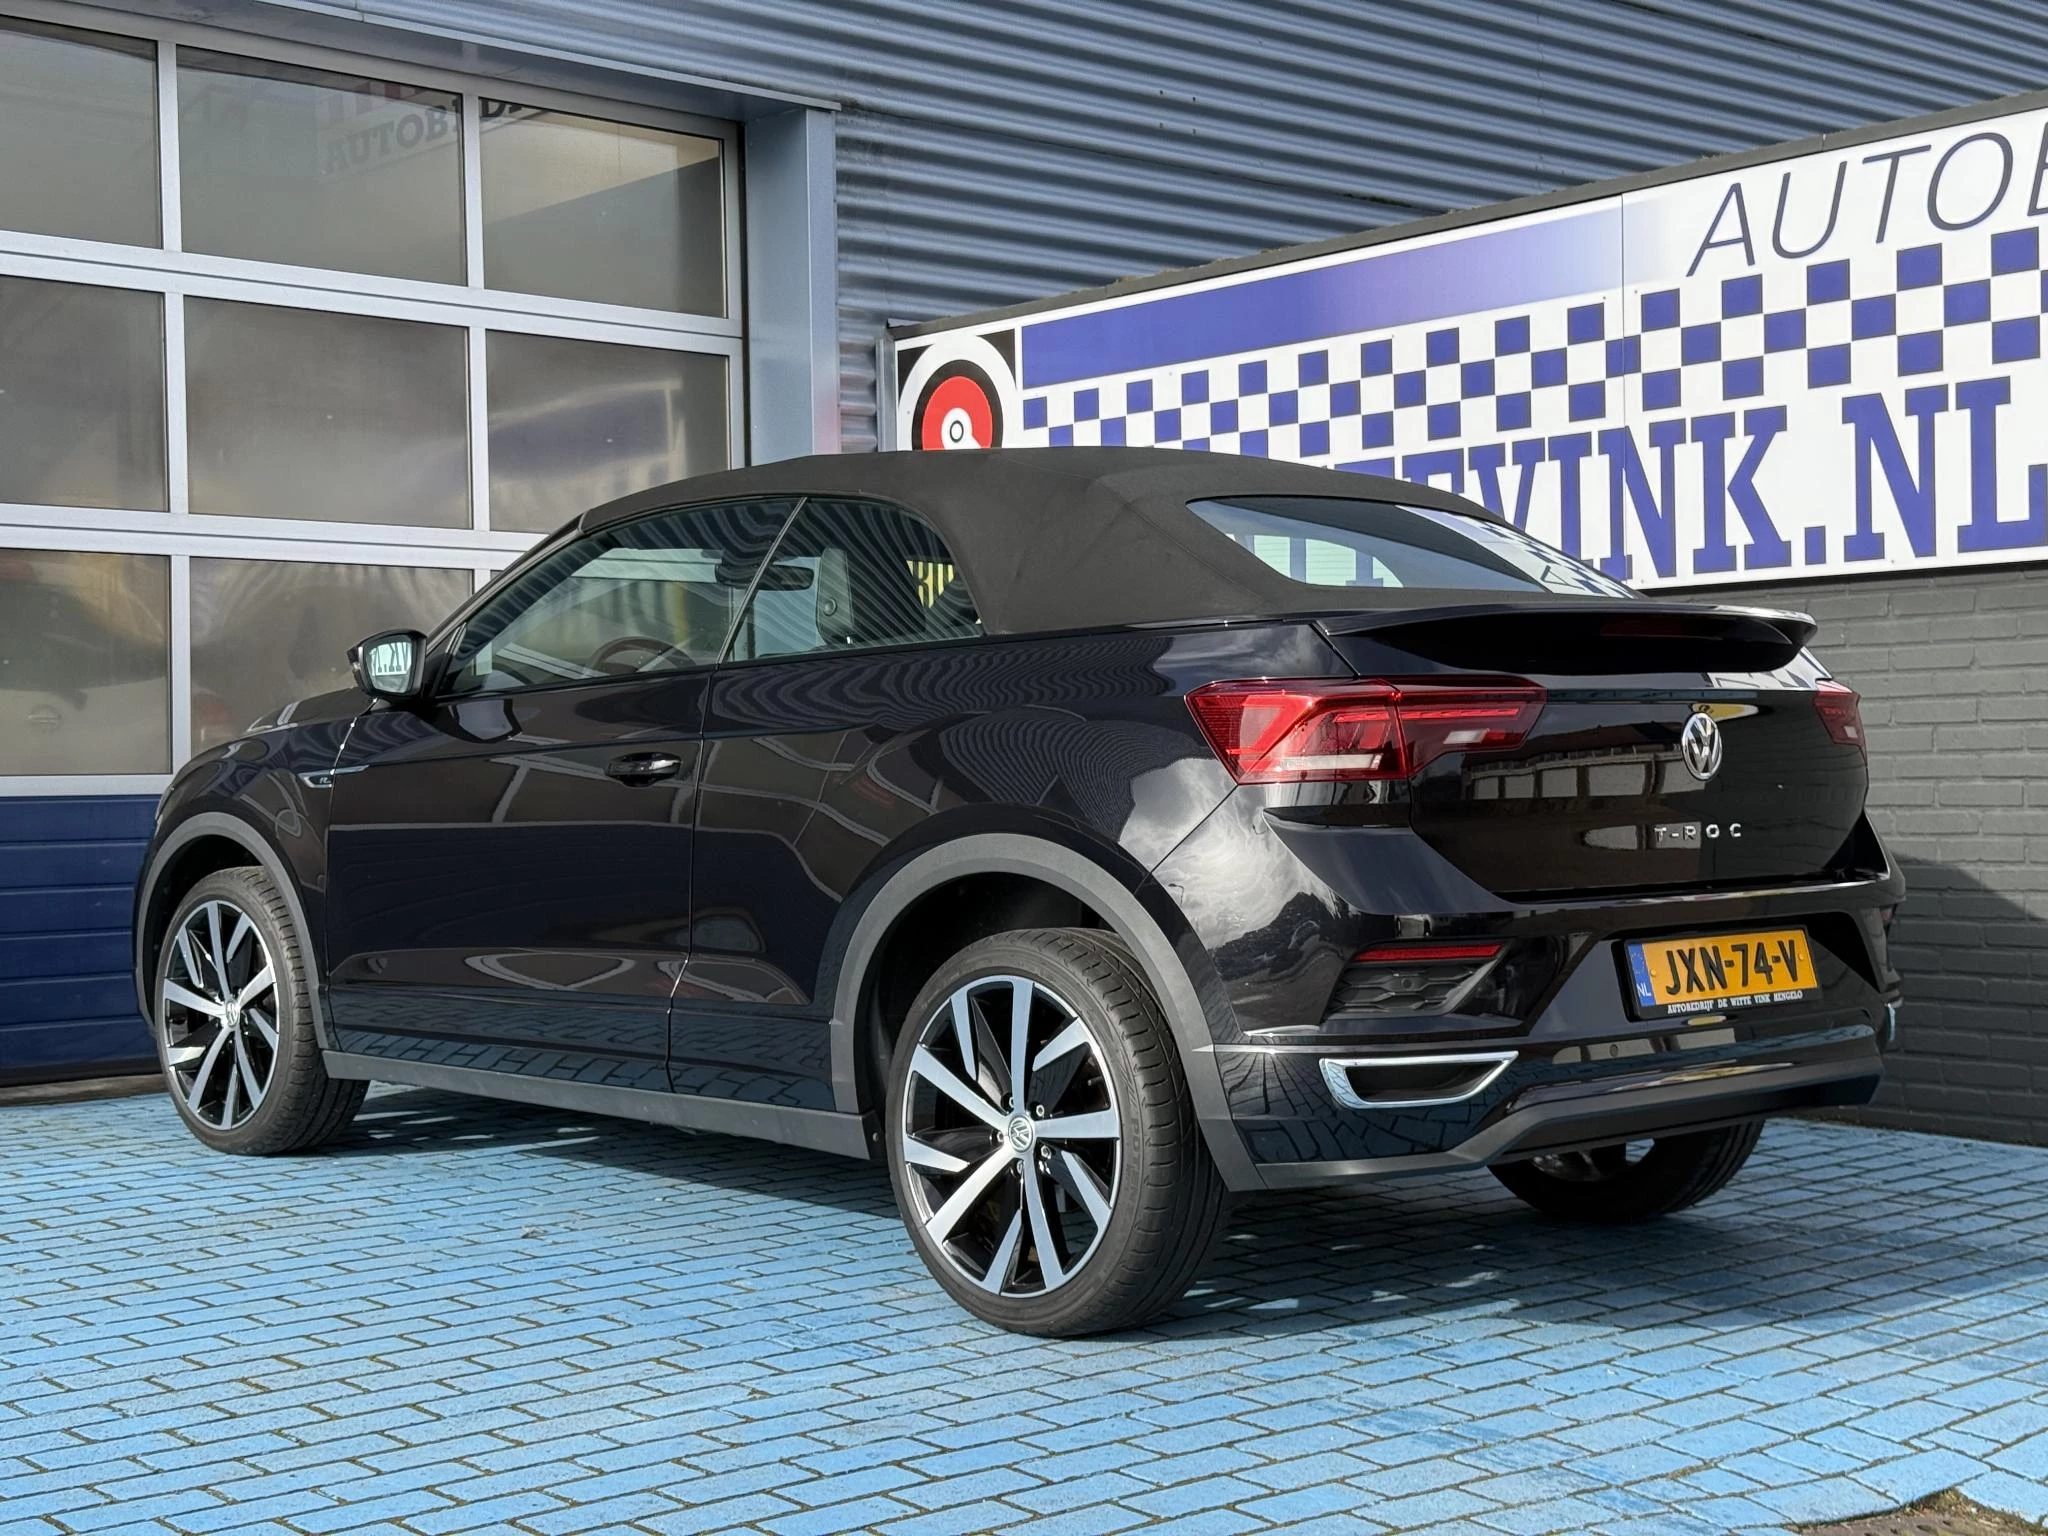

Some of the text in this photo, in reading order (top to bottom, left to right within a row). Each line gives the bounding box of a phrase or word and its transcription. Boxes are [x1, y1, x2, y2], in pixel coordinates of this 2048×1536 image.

[1665, 939, 1799, 996] JXN-74-V
[1636, 982, 1652, 998] NL
[1668, 991, 1803, 1014] AUTOBEDRIJF DE WITTE VINK HENGELO
